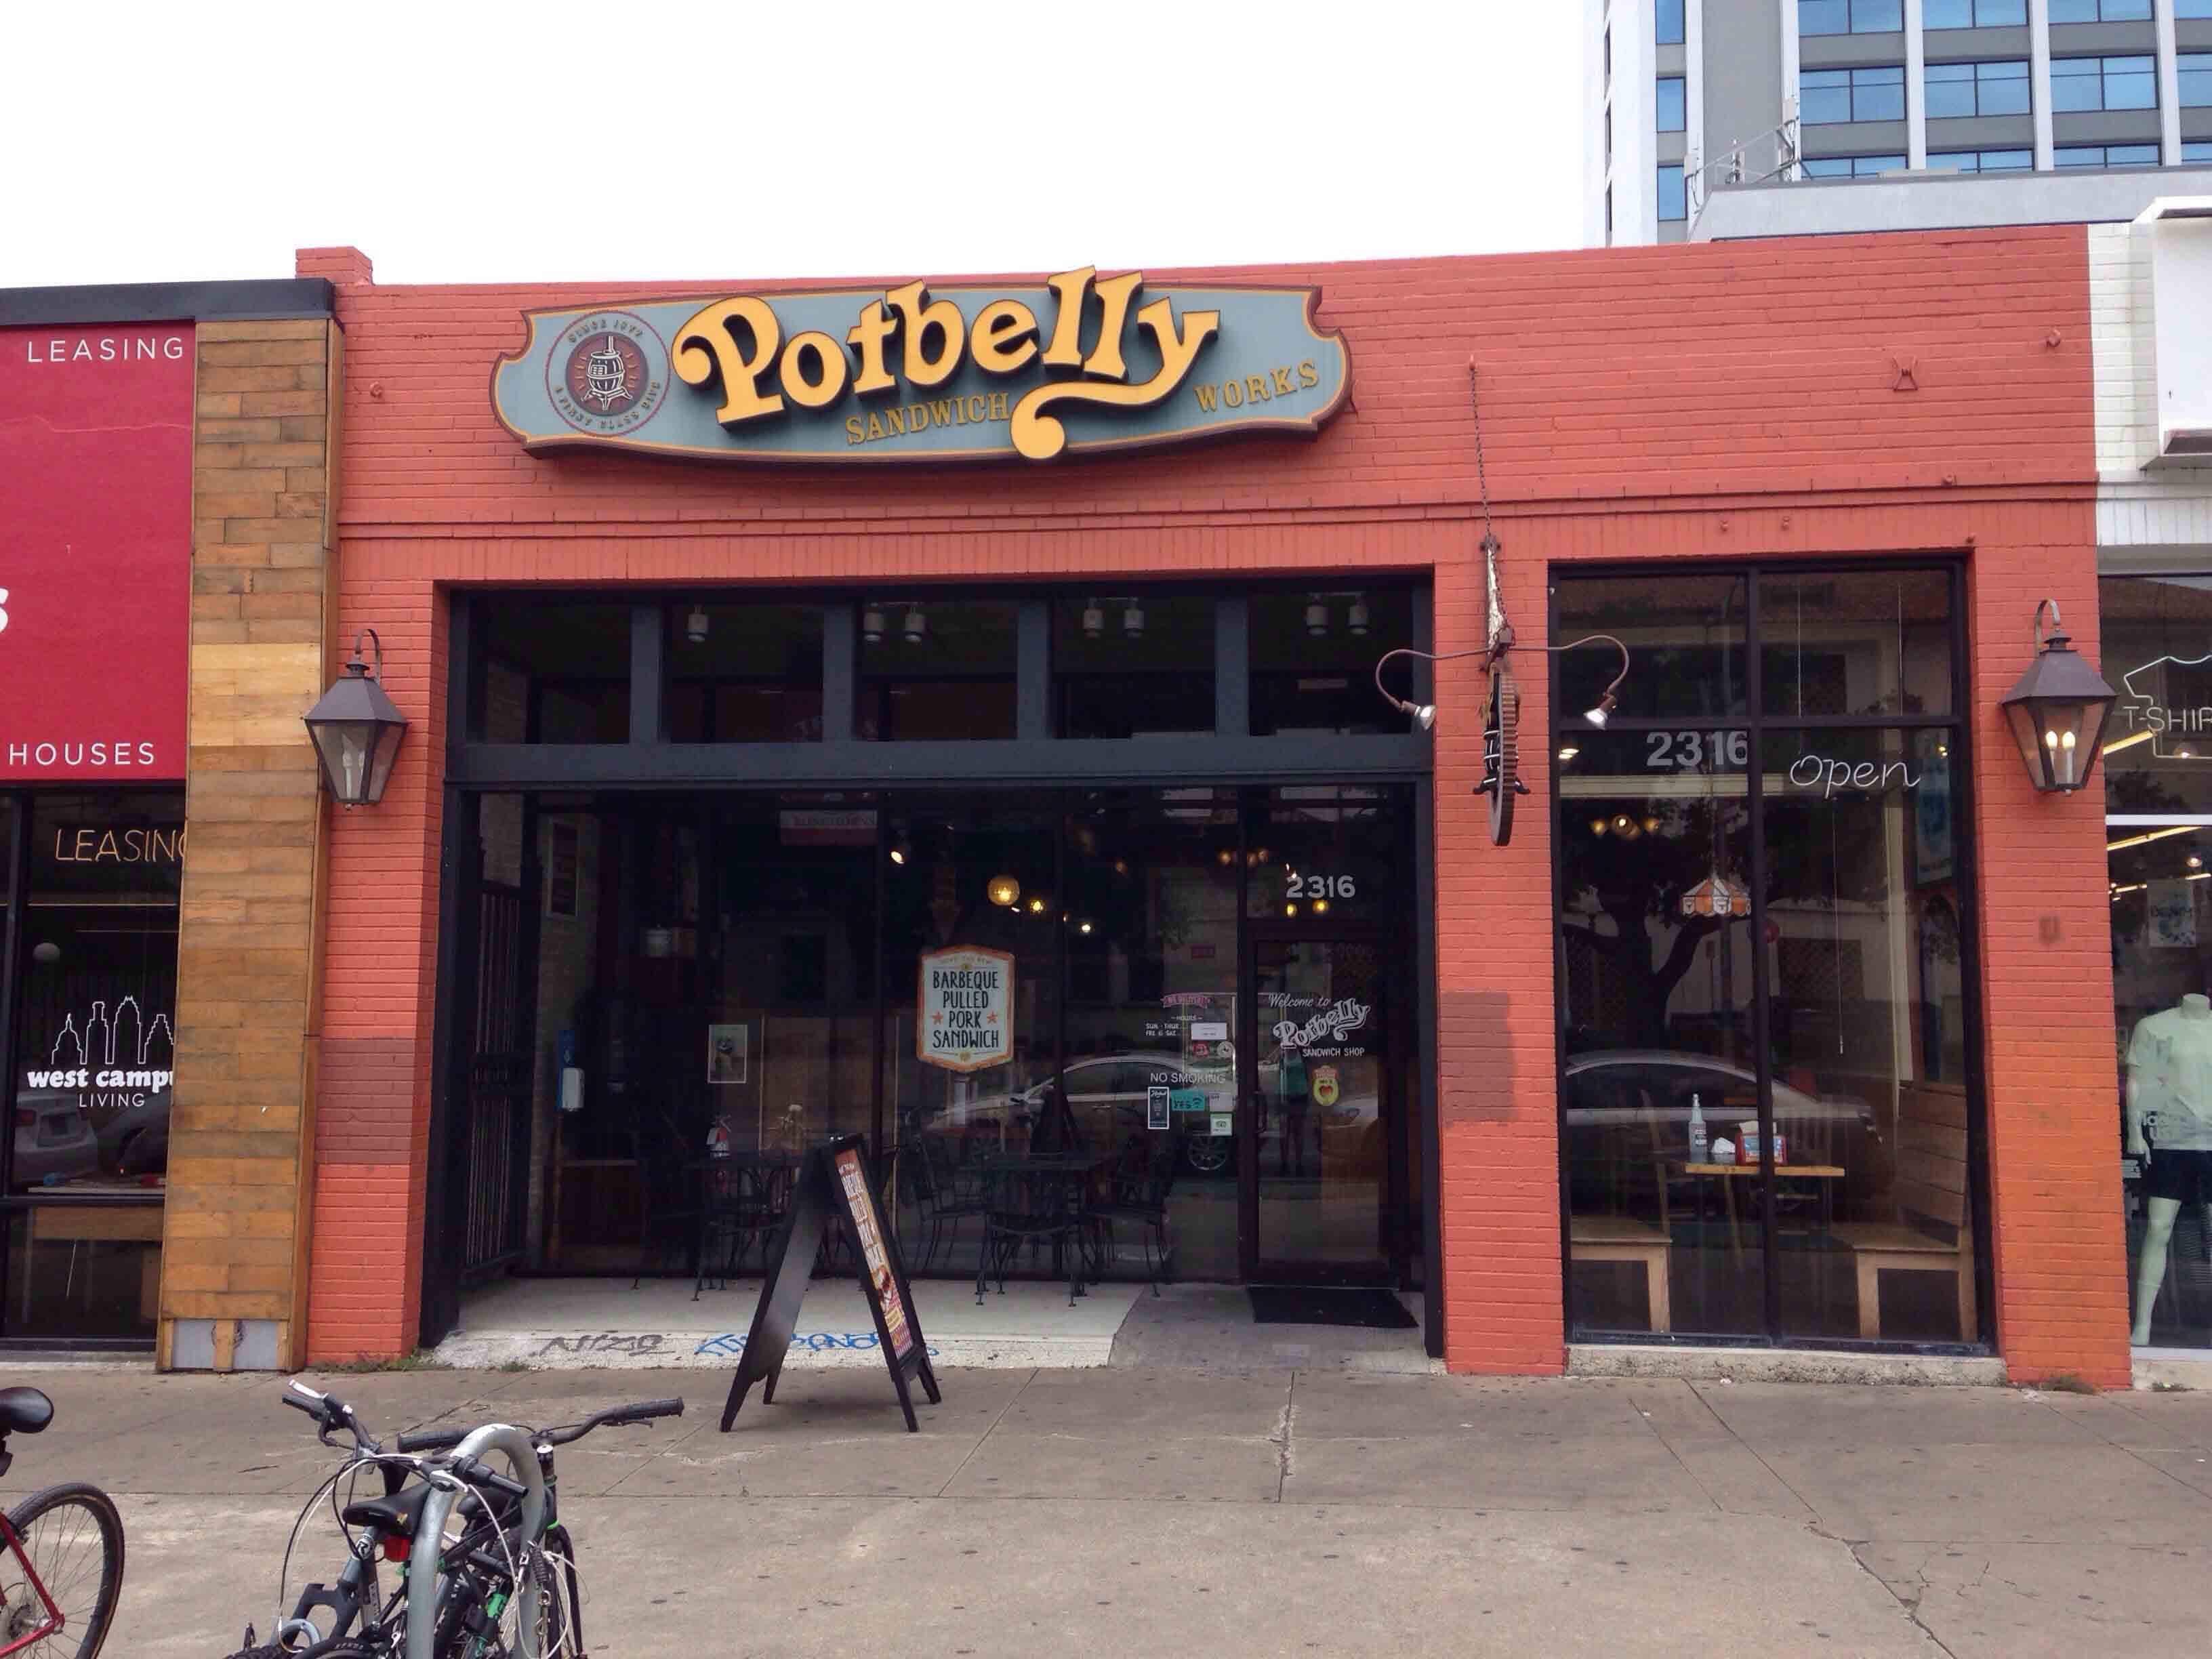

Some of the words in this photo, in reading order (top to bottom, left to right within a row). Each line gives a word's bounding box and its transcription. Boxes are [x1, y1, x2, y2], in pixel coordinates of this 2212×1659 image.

[28, 337, 183, 363] LEASING
[671, 265, 1220, 459] Potbelly
[845, 390, 1010, 445] SANDWICH
[1193, 358, 1319, 413] WORKS
[9, 742, 155, 765] HOUSES
[1647, 731, 1748, 766] 2316
[1790, 754, 1921, 799] Open
[1286, 875, 1355, 899] 2316
[933, 970, 999, 989] BARBEQUE
[943, 991, 989, 1008] PULLED
[1268, 991, 1313, 1008] Welcome
[1317, 996, 1330, 1007] to
[948, 1010, 982, 1029] PORK
[1273, 998, 1371, 1049] Potbelly
[933, 1029, 1000, 1048] SANDWICH
[1302, 1047, 1340, 1057] SANDWICH
[1344, 1047, 1365, 1057] SHOP
[27, 1068, 89, 1088] west
[95, 1069, 173, 1093] camp
[1150, 1073, 1168, 1083] NO
[1170, 1073, 1227, 1084] SMOKING
[79, 1092, 145, 1108] LIVING
